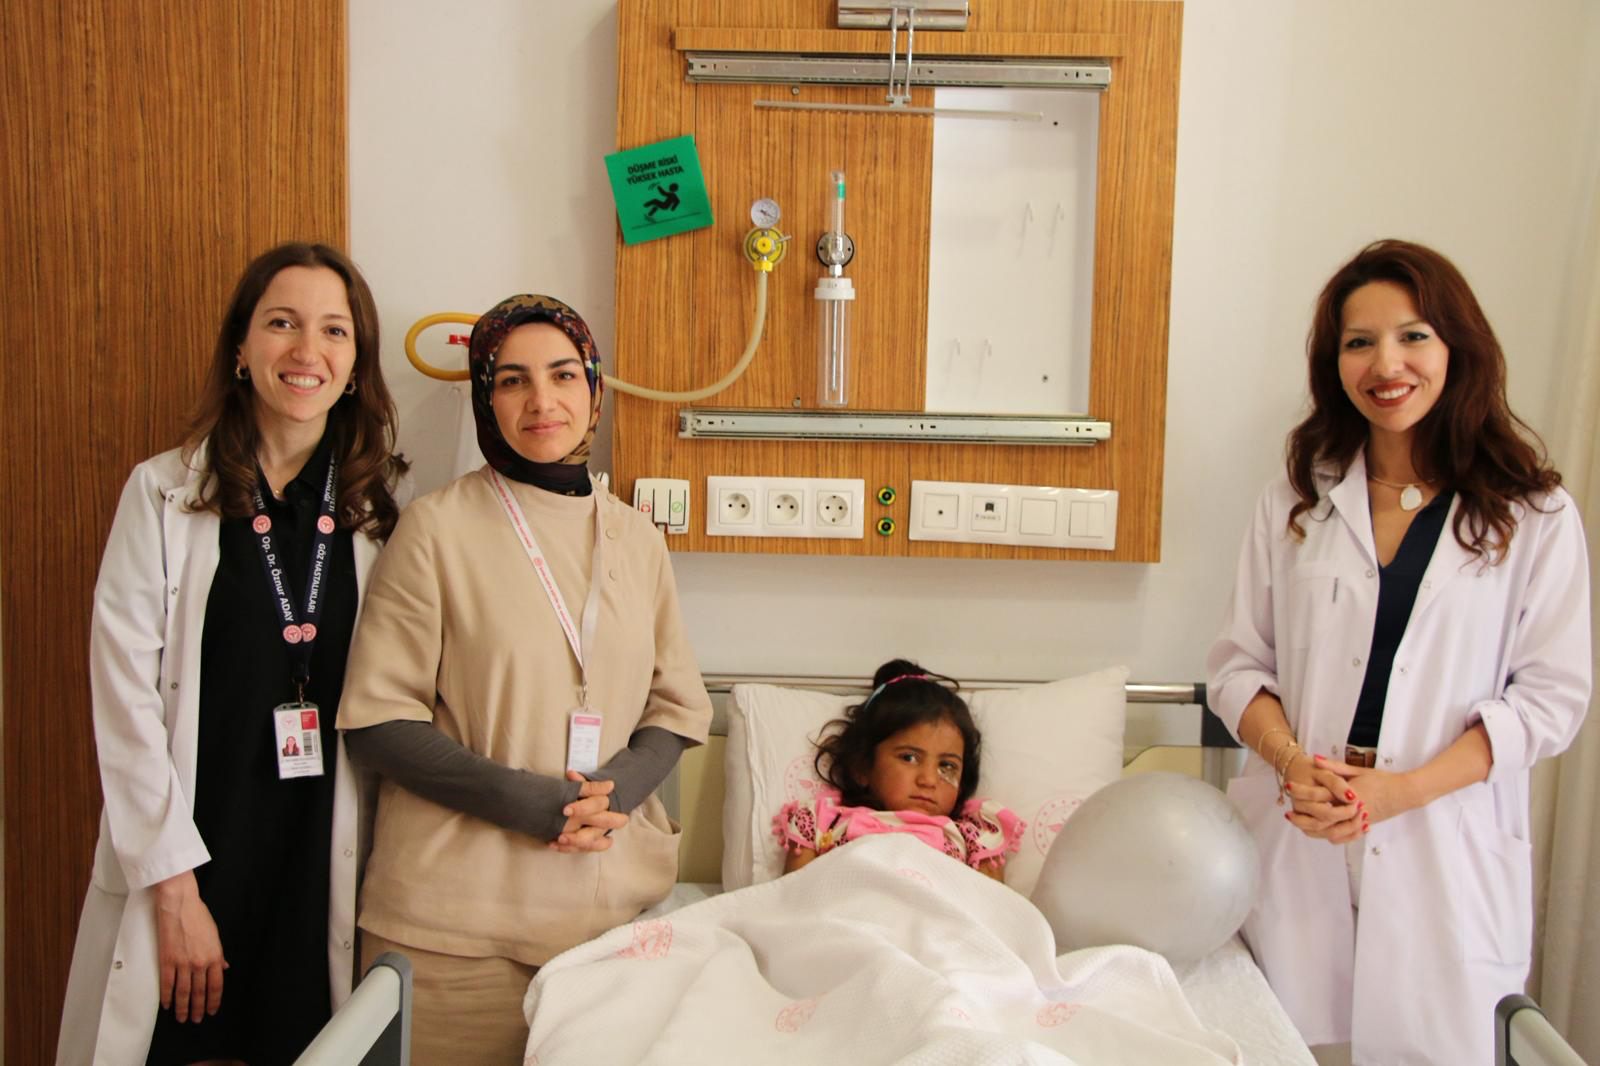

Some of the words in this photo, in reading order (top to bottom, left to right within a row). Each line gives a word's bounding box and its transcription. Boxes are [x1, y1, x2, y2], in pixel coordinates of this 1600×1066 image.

[627, 161, 656, 174] DÜŞME
[658, 155, 678, 166] RİSKİ
[627, 173, 657, 185] YÜKSEK
[658, 166, 684, 177] HASTA
[261, 535, 271, 553] Op.
[316, 543, 326, 560] GÖZ
[267, 553, 276, 567] Dr.
[271, 567, 285, 596] Öznur
[307, 560, 323, 613] HASTALIKLARI
[279, 597, 294, 622] ADAY
